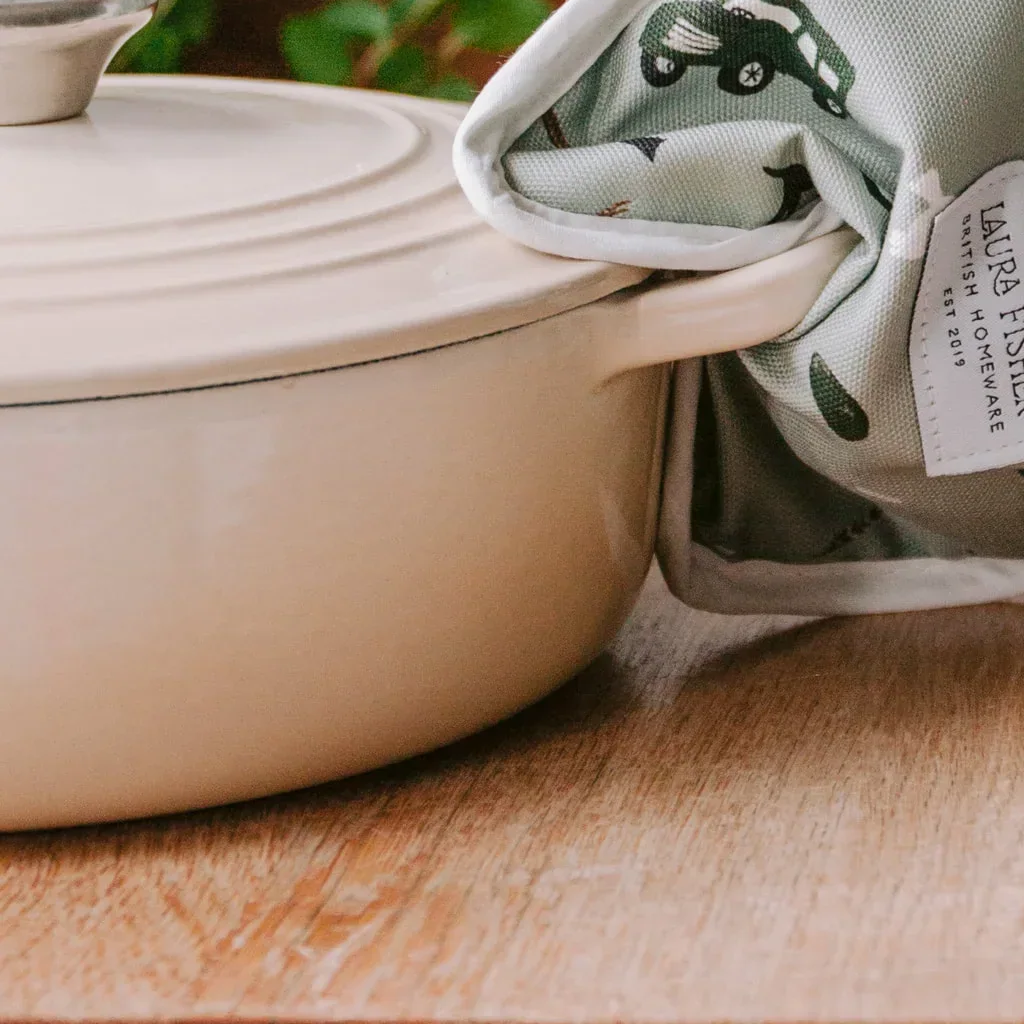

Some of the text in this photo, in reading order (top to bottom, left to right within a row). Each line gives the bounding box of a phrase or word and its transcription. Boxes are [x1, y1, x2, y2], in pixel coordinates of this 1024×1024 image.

[980, 201, 1020, 297] LAURA
[943, 287, 966, 367] EST 2019
[962, 214, 1005, 433] BRITISH HOMEWARE
